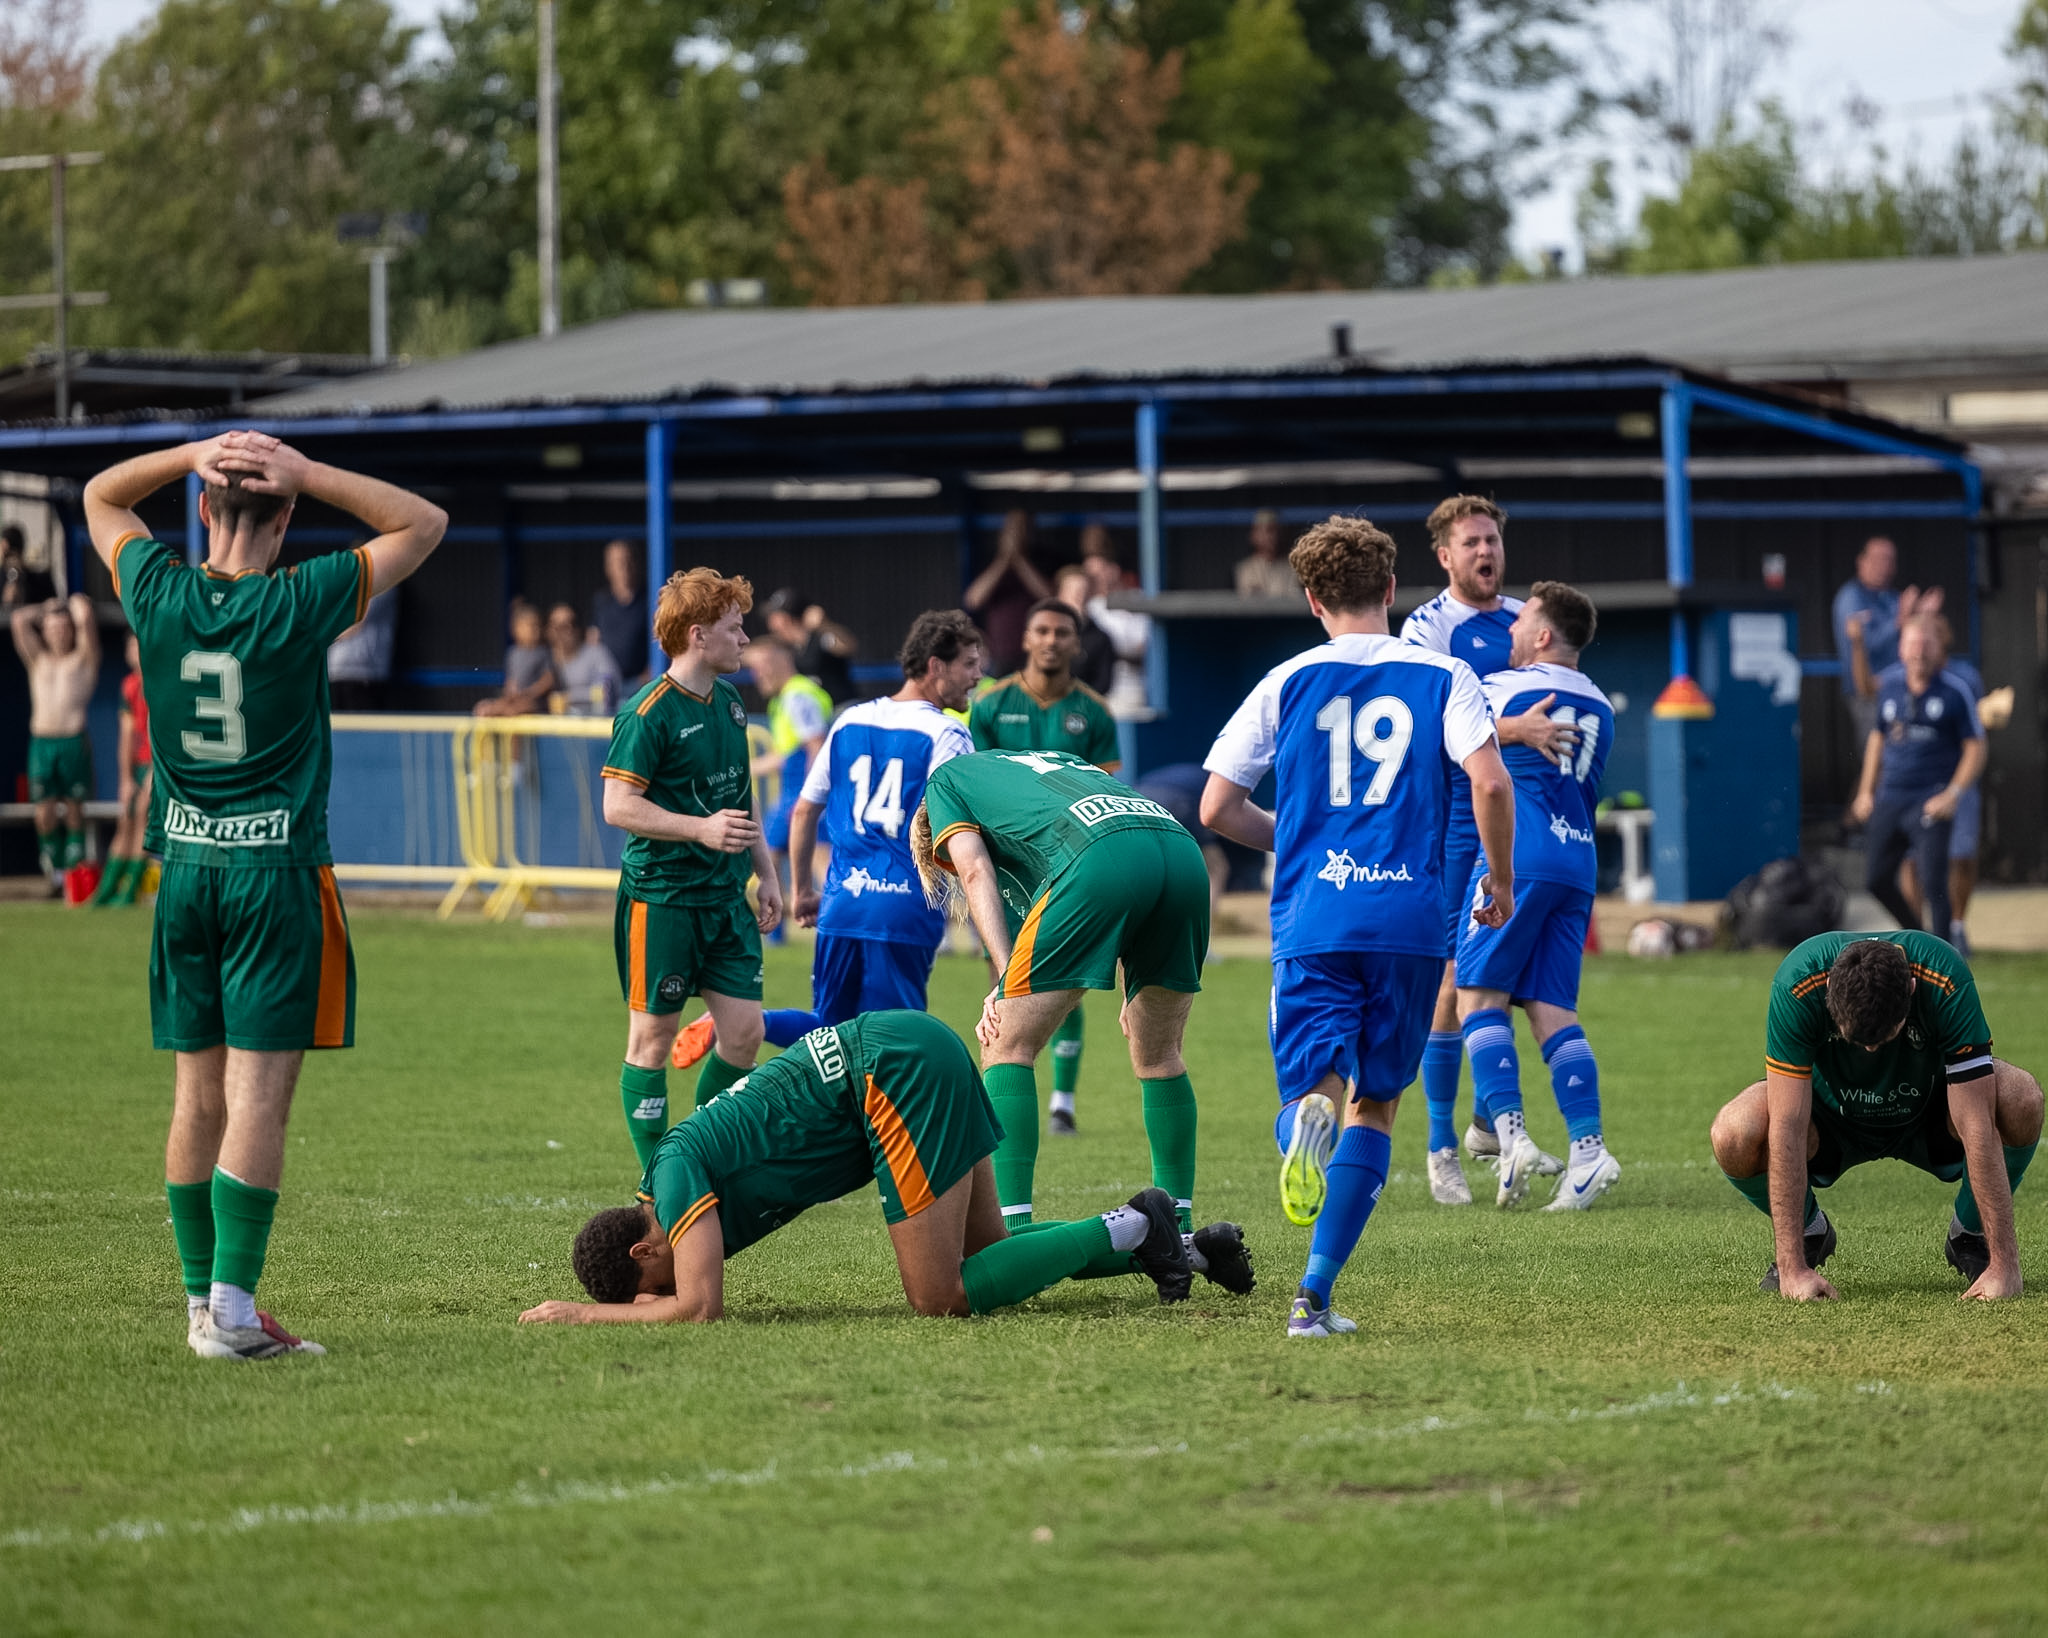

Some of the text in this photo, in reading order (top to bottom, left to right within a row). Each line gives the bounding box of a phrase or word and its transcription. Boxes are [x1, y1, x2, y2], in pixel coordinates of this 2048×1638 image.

[180, 650, 247, 762] 3
[1550, 705, 1600, 784] 11
[1316, 695, 1414, 807] 19
[849, 753, 905, 839] 14
[865, 876, 912, 894] mind
[1352, 863, 1413, 883] mind
[1840, 1082, 1921, 1105] White & Co.
